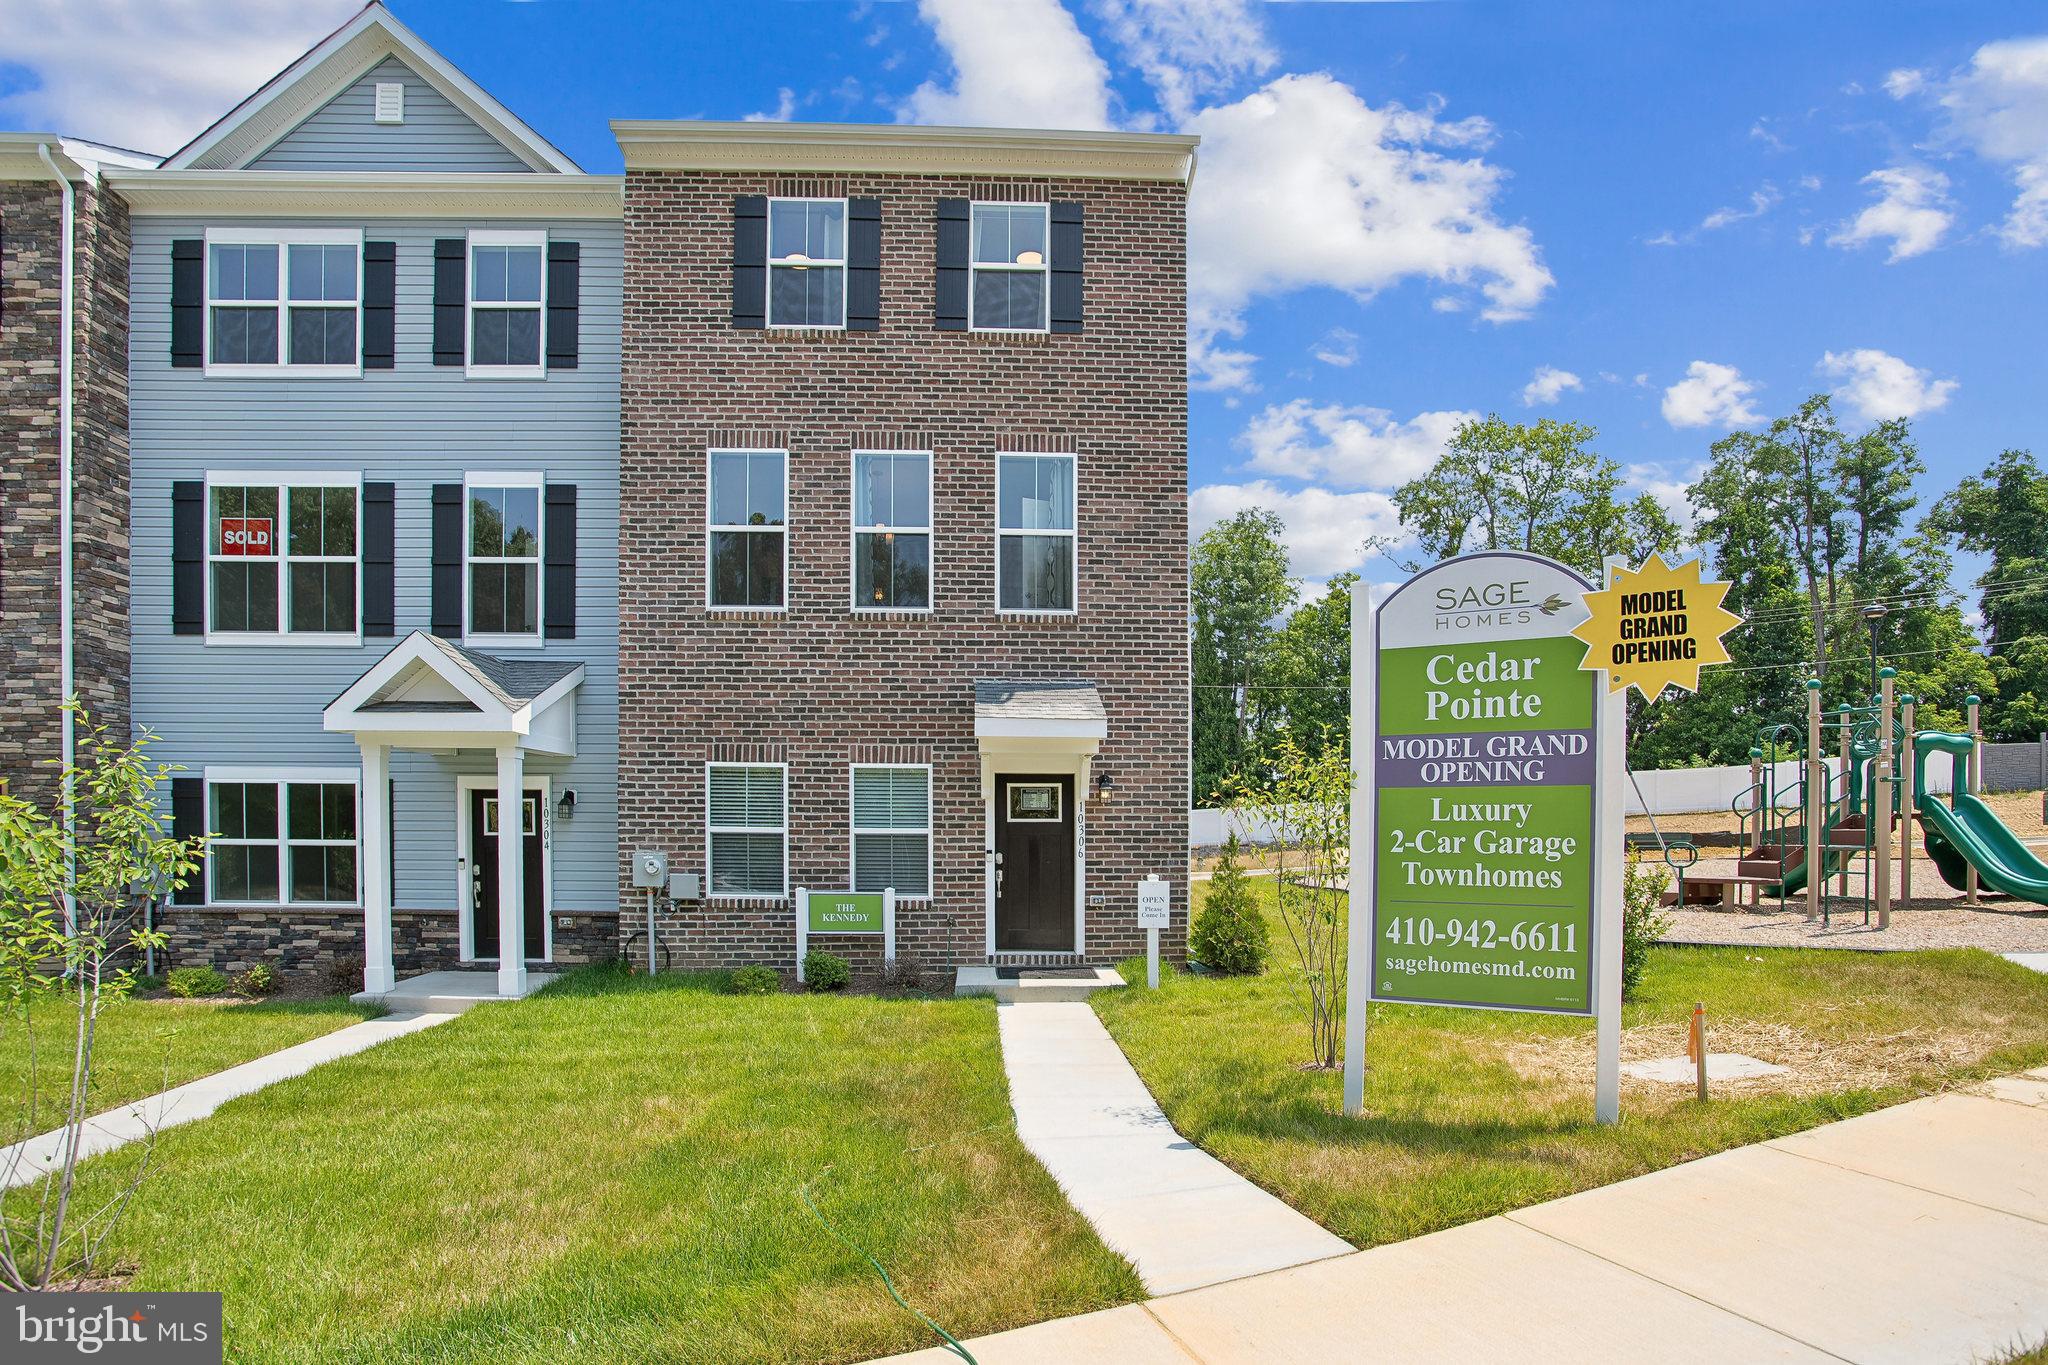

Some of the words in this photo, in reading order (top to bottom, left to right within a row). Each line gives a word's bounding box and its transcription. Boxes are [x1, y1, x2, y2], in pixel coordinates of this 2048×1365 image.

[224, 530, 268, 544] SOLD
[1435, 580, 1531, 611] SAGE
[1620, 589, 1687, 616] MODEL
[1435, 610, 1531, 630] HOMES
[1620, 614, 1688, 640] GRAND
[1612, 637, 1697, 664] OPENING
[1425, 653, 1542, 686] Cedar
[1424, 688, 1542, 721] Pointe
[1382, 737, 1479, 760] MODEL
[1486, 734, 1588, 757] GRAND
[1420, 759, 1545, 783] OPENING
[1430, 798, 1533, 828] Luxury
[1077, 801, 1085, 858] 10306
[1390, 829, 1467, 855] 2-Car
[1473, 832, 1577, 861] Garage
[1401, 861, 1563, 889] Townhomes
[822, 913, 870, 922] KENNEDY
[836, 903, 856, 912] THE
[1385, 917, 1578, 953] 410-942-6611
[1385, 955, 1576, 981] sagehomesmd.com
